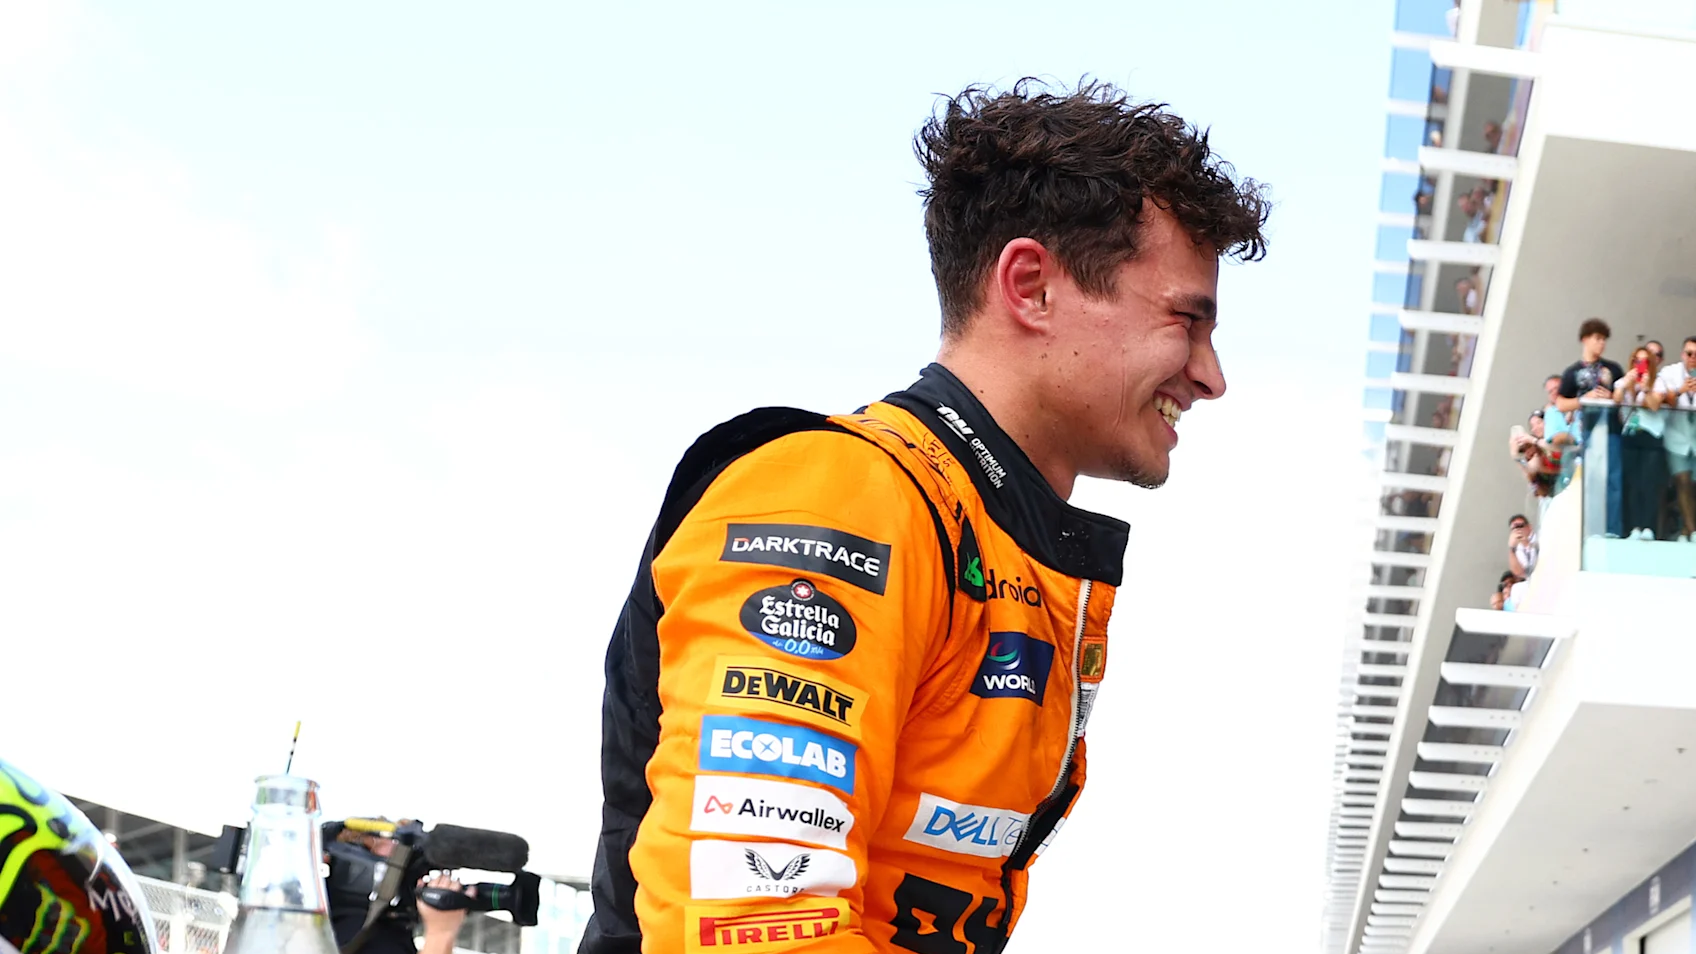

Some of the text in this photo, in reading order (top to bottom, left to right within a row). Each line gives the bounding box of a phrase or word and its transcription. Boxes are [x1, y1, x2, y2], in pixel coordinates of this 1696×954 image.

[971, 437, 1007, 479] OPTIMUM
[732, 536, 881, 577] DARKTRACE
[759, 595, 840, 629] Estrella
[761, 615, 835, 646] Galicia
[710, 729, 847, 778] ECOLAB
[738, 798, 845, 833] Airwallex
[746, 885, 804, 894] CASTOR
[699, 907, 840, 947] PIRELLI
